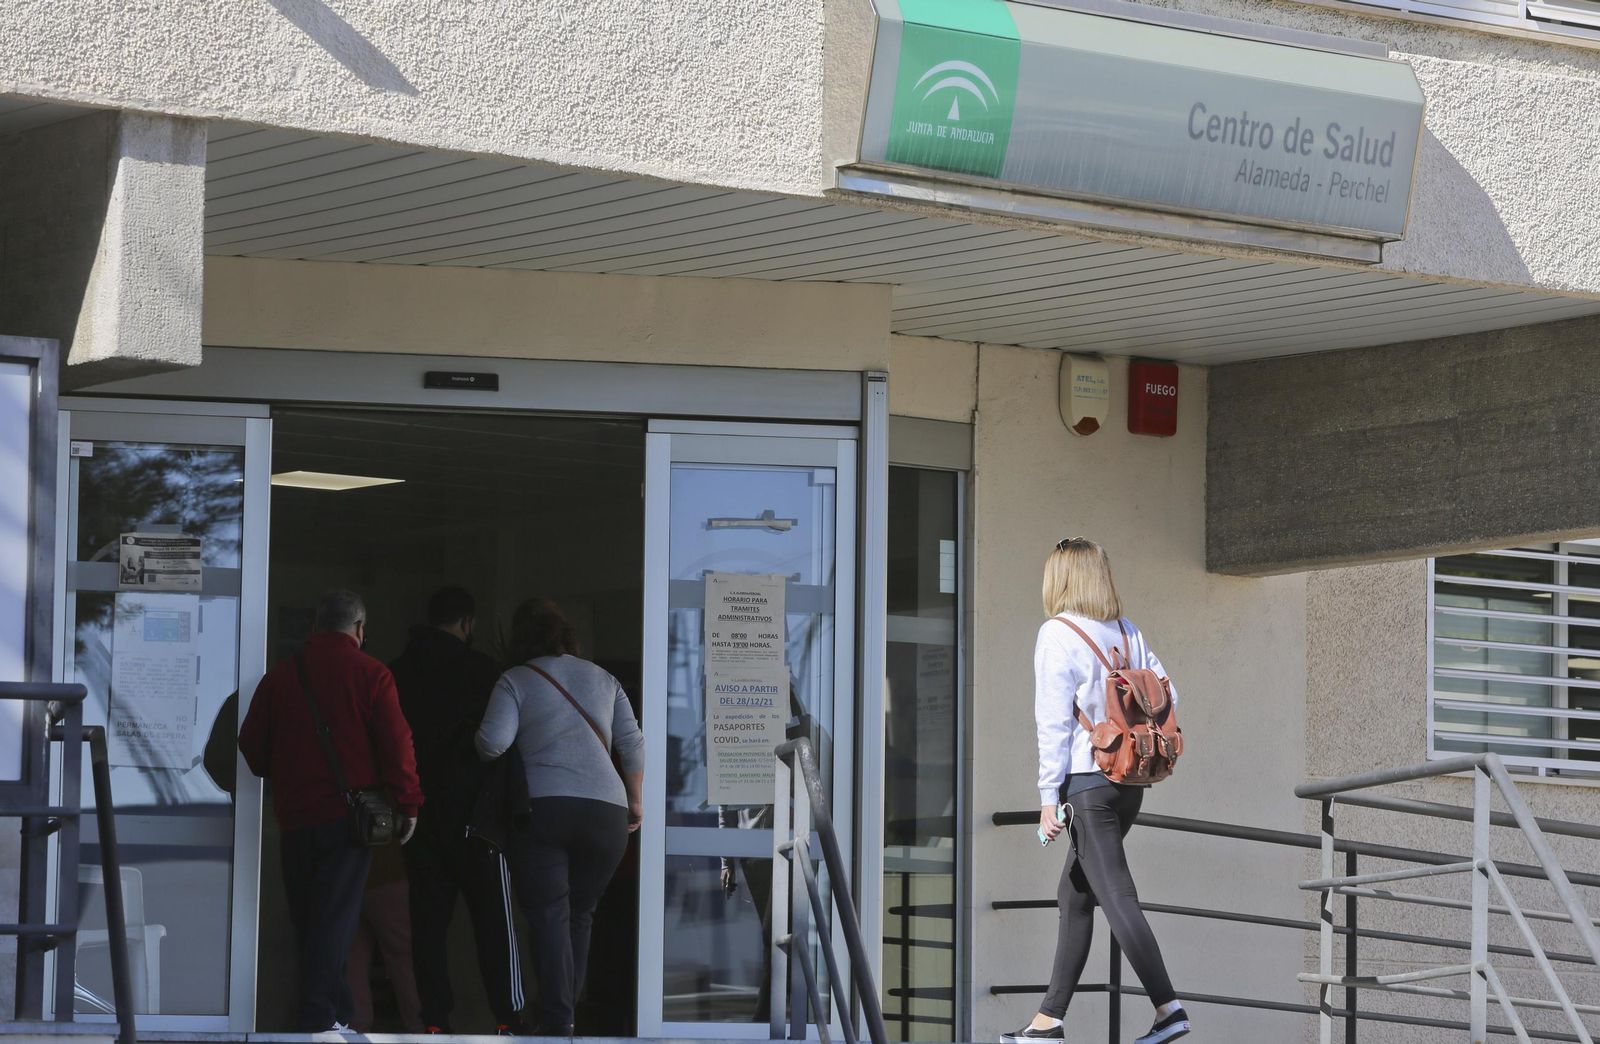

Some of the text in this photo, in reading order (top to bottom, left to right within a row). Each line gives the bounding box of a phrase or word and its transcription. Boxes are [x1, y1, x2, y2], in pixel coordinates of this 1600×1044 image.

[906, 121, 995, 145] JUNTA DE ANDALUCIA
[1187, 102, 1396, 168] Centro de Salud
[1234, 158, 1311, 193] Alameda
[1328, 171, 1391, 204] Perchel
[1145, 383, 1176, 397] FUEGO
[731, 605, 760, 613] TRAMITES
[717, 614, 773, 623] ADMINISTRATIVOS
[715, 684, 778, 693] AVISO A PARTIR
[720, 697, 774, 707] DEL 28/12/21
[713, 723, 765, 731] PASAPORTES
